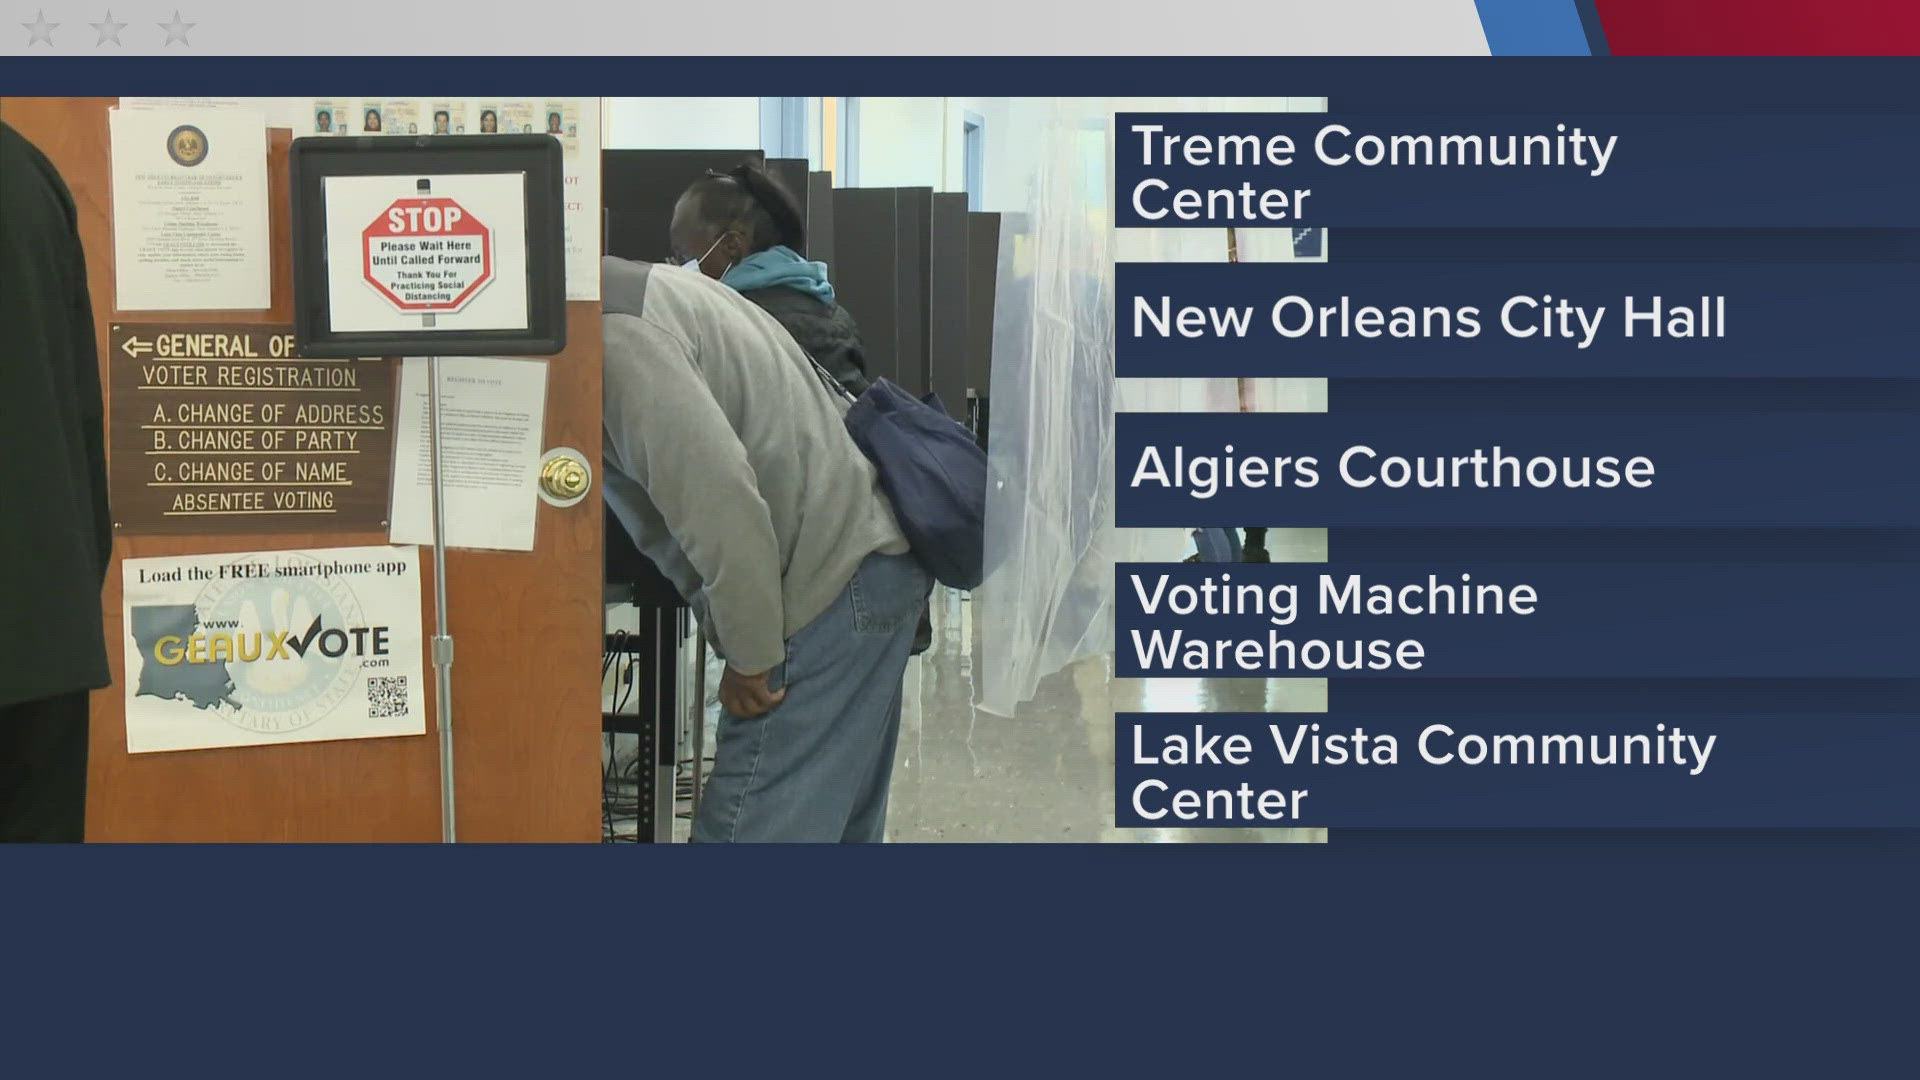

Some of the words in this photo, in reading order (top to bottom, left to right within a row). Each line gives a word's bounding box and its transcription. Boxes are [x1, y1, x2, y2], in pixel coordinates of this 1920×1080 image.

[388, 206, 461, 233] STOP
[380, 241, 416, 252] Please
[419, 241, 443, 250] Wait
[446, 240, 472, 250] Here
[372, 256, 398, 266] Until
[400, 255, 435, 265] Called
[438, 254, 481, 265] Forward
[397, 271, 423, 279] Thank
[426, 271, 441, 279] You
[443, 270, 457, 278] For
[390, 282, 435, 291] Practicing
[437, 281, 465, 289] Social
[405, 292, 451, 301] Distancing
[156, 333, 259, 358] GENERAL
[268, 335, 296, 358] OF
[143, 364, 208, 386] VOTER
[217, 366, 356, 387] REGISTRATION
[154, 403, 172, 423] A.
[178, 403, 254, 423] CHANGE
[261, 403, 286, 423] OF
[295, 404, 384, 424] ADDRESS
[154, 431, 172, 450] B.
[178, 431, 254, 450] CHANGE
[261, 431, 286, 450] OF
[295, 431, 358, 450] PARTY
[154, 462, 172, 481] C.
[178, 462, 254, 481] CHANGE
[261, 462, 286, 481] OF
[295, 462, 347, 481] NAME
[172, 492, 265, 511] ABSENTEE
[273, 490, 334, 509] VOTING
[139, 566, 182, 584] Load
[187, 565, 214, 581] the
[219, 563, 270, 580] FREE
[275, 560, 372, 578] smartphone
[376, 560, 407, 577] app
[203, 620, 244, 630] www.
[359, 657, 390, 668] .com
